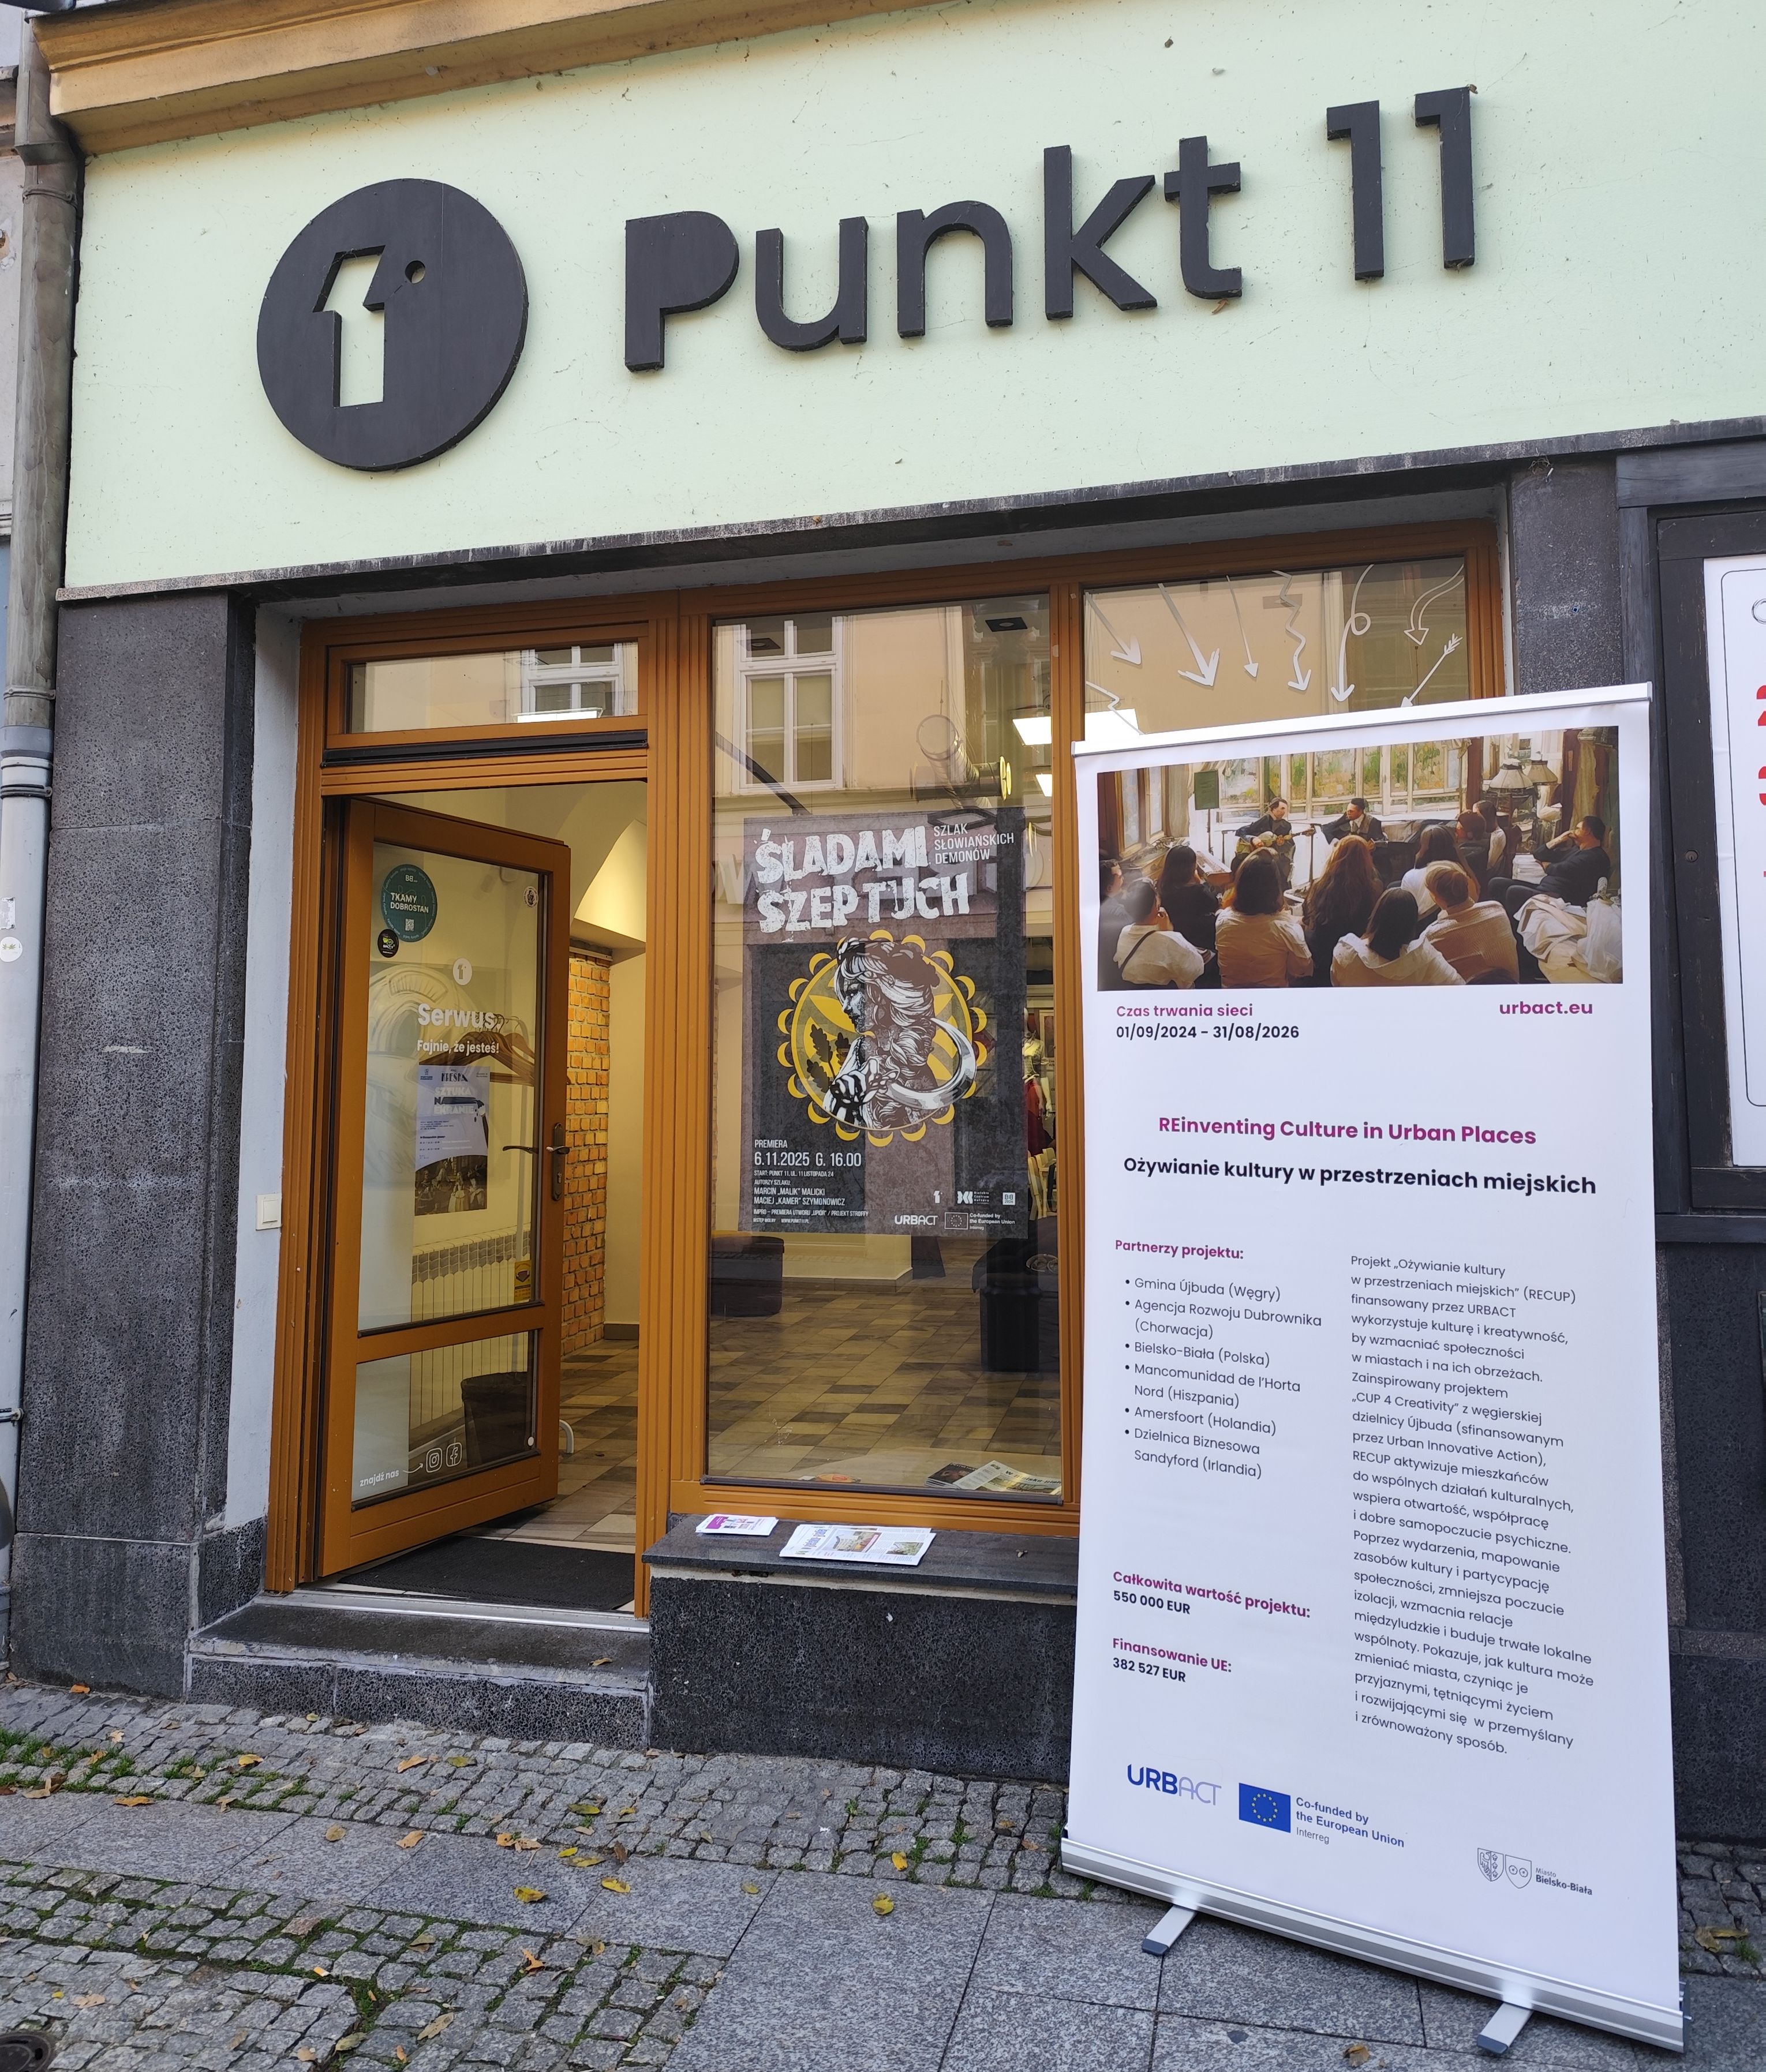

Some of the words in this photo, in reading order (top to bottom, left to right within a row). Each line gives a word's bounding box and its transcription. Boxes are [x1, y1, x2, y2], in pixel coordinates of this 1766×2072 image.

[624, 136, 1243, 372] Punkt
[1326, 86, 1476, 281] 11
[934, 823, 968, 837] SZLAK
[934, 833, 1015, 850] SŁOWIAŃSKICH
[754, 826, 930, 884] ŚLADAMI
[935, 849, 990, 864] DEMONÓW
[390, 893, 417, 903] TKAMY
[390, 902, 429, 913] DOBROSTAN
[1116, 1006, 1150, 1017] Czas
[1153, 1003, 1213, 1017] trwania
[1217, 1003, 1253, 1017] sieci
[1499, 1001, 1593, 1015] urbact.eu
[1116, 1022, 1197, 1041] 01/09/2024
[1213, 1022, 1300, 1041] 31/08/2026
[417, 1040, 451, 1055] Fajnie,
[454, 1041, 465, 1052] że
[466, 1040, 499, 1056] jesteś!
[435, 1086, 472, 1096] SZTUKA
[434, 1106, 474, 1115] EKRANIE
[1159, 1116, 1275, 1141] REinventing
[1280, 1121, 1359, 1138] Culture
[1363, 1121, 1383, 1140] in
[1389, 1123, 1456, 1142] Urban
[1461, 1125, 1536, 1145] Places
[755, 1140, 788, 1148] PREMIERA
[754, 1152, 810, 1166] 6.11.2025
[815, 1152, 826, 1166] G.
[830, 1152, 862, 1167] 16.00
[1124, 1157, 1220, 1178] Ożywianie
[1224, 1161, 1294, 1185] kultury
[1298, 1167, 1316, 1181] w
[1320, 1168, 1478, 1189] przestrzeniach
[1483, 1172, 1596, 1197] miejskich
[802, 1198, 845, 1206] SZYMONOWICZ
[895, 1215, 938, 1226] URBACT
[1115, 1239, 1179, 1258] Partnerzy
[1181, 1245, 1244, 1260] projektu:
[1351, 1256, 1391, 1269] Projekt
[1464, 1262, 1506, 1279] kultury
[1135, 1277, 1176, 1291] Gmina
[1180, 1279, 1225, 1296] Újbuda
[1229, 1282, 1281, 1303] (Węgry)
[1350, 1276, 1361, 1285] w
[1364, 1277, 1453, 1292] przestrzeniach
[1524, 1286, 1576, 1305] (RECUP)
[1135, 1299, 1185, 1316] Agencja
[1189, 1303, 1240, 1321] Rozwoju
[1244, 1308, 1322, 1327] Dubrownika
[1351, 1293, 1429, 1313] finansowany
[1432, 1302, 1464, 1314] przez
[1467, 1303, 1517, 1318] URBACT
[1135, 1317, 1213, 1340] (Chorwacja)
[1351, 1314, 1428, 1332] wykorzystuje
[1431, 1320, 1474, 1336] kulturę
[1477, 1324, 1480, 1335] i
[1484, 1324, 1568, 1345] kreatywność,
[1135, 1342, 1214, 1360] Bielsko-Biała
[1218, 1347, 1270, 1369] (Polska)
[1352, 1332, 1367, 1347] by
[1369, 1336, 1440, 1351] wzmacniać
[1443, 1343, 1524, 1359] społeczności
[1135, 1363, 1234, 1384] Mancomunidad
[1238, 1374, 1255, 1387] de
[1351, 1354, 1362, 1362] w
[1365, 1354, 1423, 1369] miastach
[1426, 1359, 1429, 1369] i
[1432, 1362, 1449, 1372] na
[1452, 1361, 1471, 1374] ich
[1474, 1365, 1543, 1382] obrzeżach.
[1135, 1384, 1163, 1398] Nord
[1168, 1385, 1239, 1410] (Hiszpania)
[1352, 1372, 1441, 1393] Zainspirowany
[1444, 1383, 1508, 1399] projektem
[1134, 1406, 1204, 1425] Amersfoort
[1208, 1412, 1276, 1437] (Holandia)
[1383, 1395, 1392, 1405] 4
[1462, 1405, 1468, 1414] z
[1471, 1406, 1542, 1427] węgierskiej
[1135, 1427, 1189, 1445] Dzielnica
[1193, 1435, 1260, 1455] Biznesowa
[1352, 1411, 1405, 1430] dzielnicy
[1408, 1415, 1452, 1433] Újbuda
[1456, 1421, 1563, 1448] (sfinansowanym
[1352, 1432, 1384, 1444] przez
[1387, 1435, 1424, 1449] Urban
[1427, 1440, 1494, 1458] Innovative
[1496, 1449, 1546, 1467] Action),
[1134, 1449, 1199, 1468] Sandyford
[1203, 1456, 1262, 1480] (Irlandia)
[360, 1472, 384, 1487] znajdź
[385, 1470, 399, 1479] nas
[1113, 1571, 1182, 1594] Całkowita
[1185, 1585, 1242, 1605] wartość
[1245, 1597, 1311, 1618] projektu:
[1113, 1590, 1137, 1604] 550
[1139, 1594, 1164, 1609] 000
[1166, 1599, 1191, 1615] EUR
[1113, 1638, 1208, 1668] Finansowanie
[1211, 1657, 1232, 1673] UE:
[1113, 1657, 1135, 1672] 382
[1138, 1662, 1160, 1676] 527
[1162, 1667, 1186, 1683] EUR
[1127, 1763, 1222, 1806] URBACT
[1296, 1797, 1352, 1820] Co-funded
[1355, 1811, 1369, 1826] by
[1296, 1811, 1313, 1823] the
[1316, 1815, 1368, 1838] European
[1371, 1830, 1404, 1848] Union
[1296, 1827, 1330, 1845] Interreg
[1535, 1867, 1557, 1878] Miasto
[1536, 1874, 1593, 1895] Bielsko-Biała
